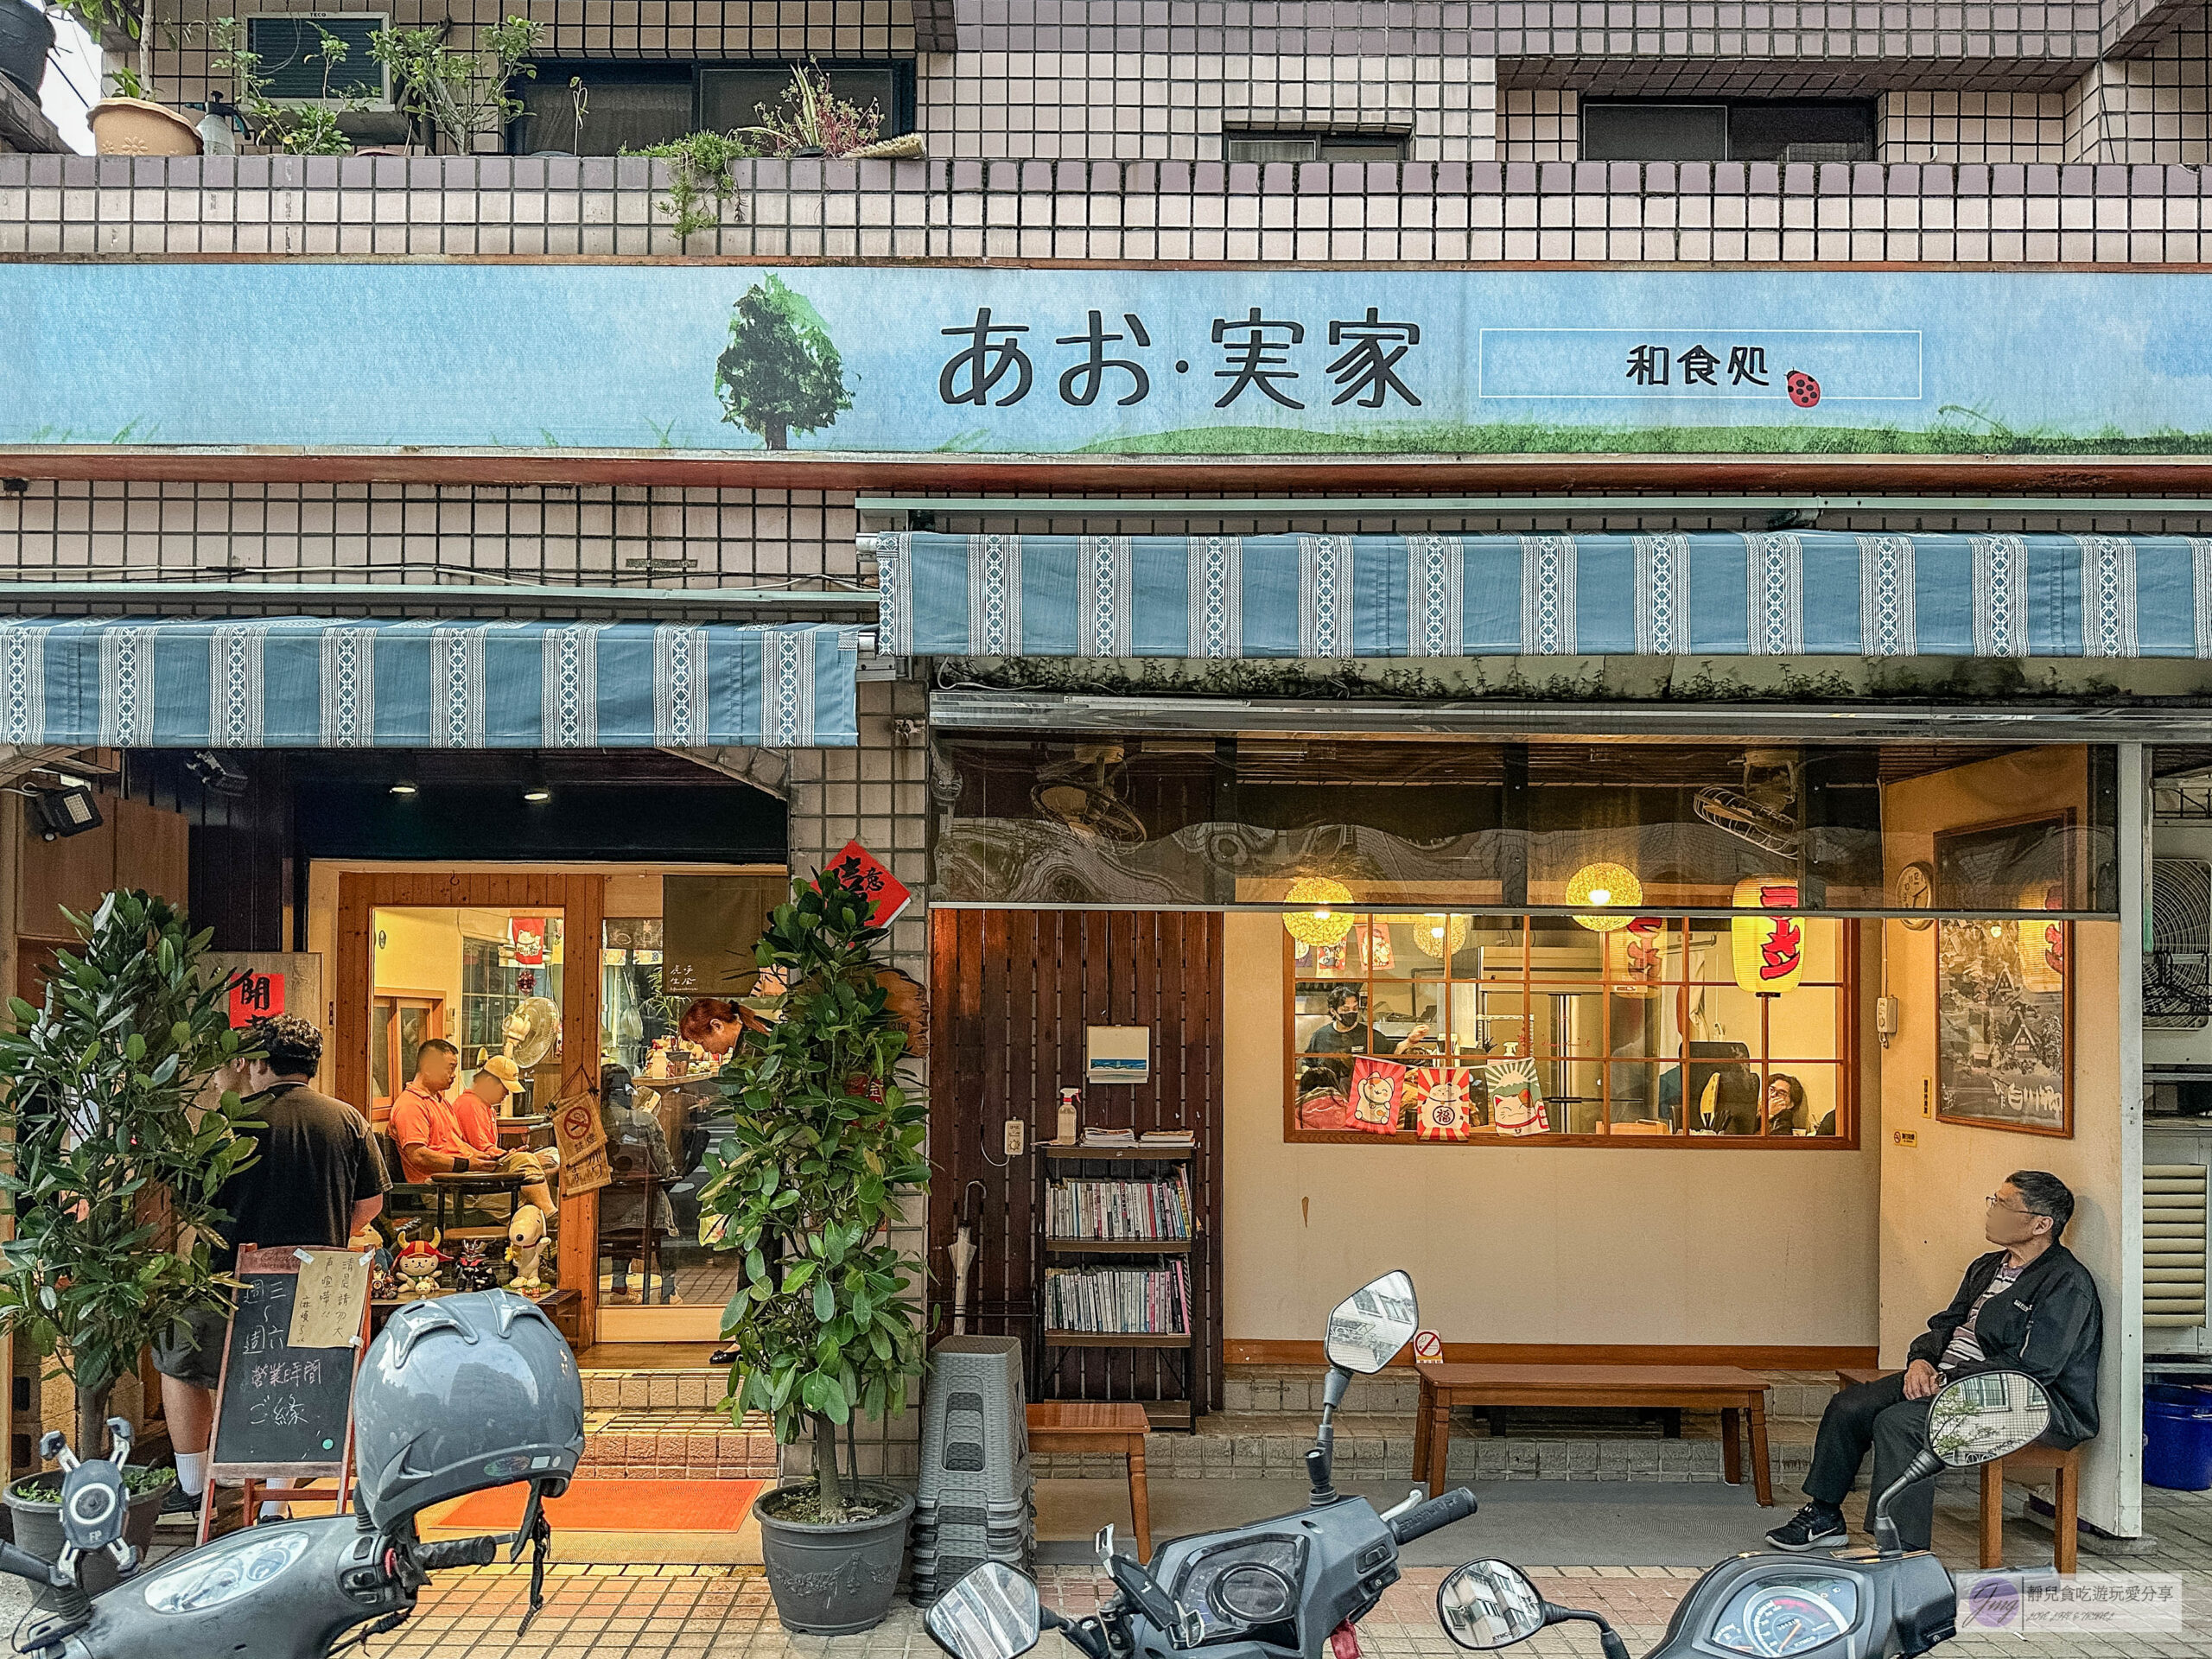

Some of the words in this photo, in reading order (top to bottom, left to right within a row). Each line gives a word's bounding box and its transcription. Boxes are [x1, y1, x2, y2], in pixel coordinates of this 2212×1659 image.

[1625, 344, 1770, 386] 和食処
[1435, 1108, 1452, 1123] 福
[243, 1278, 287, 1304] 週三
[243, 1325, 284, 1355] 週六
